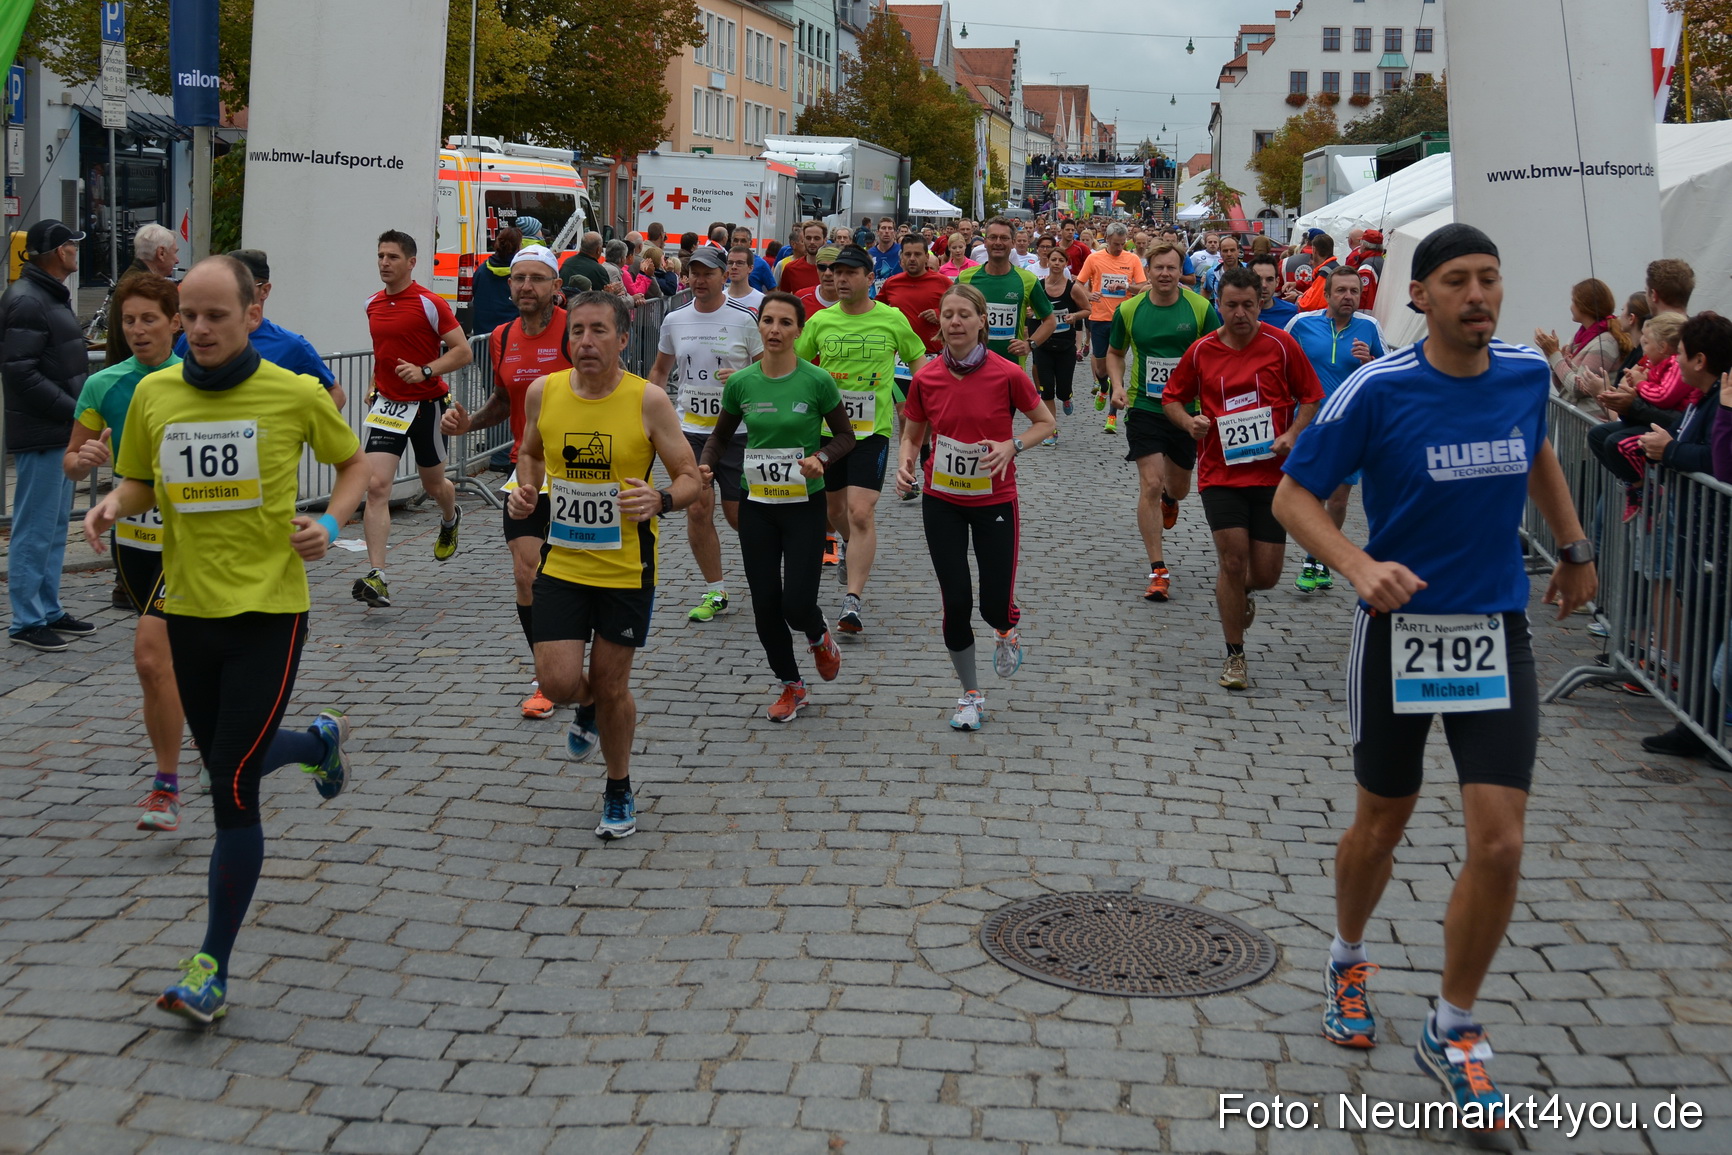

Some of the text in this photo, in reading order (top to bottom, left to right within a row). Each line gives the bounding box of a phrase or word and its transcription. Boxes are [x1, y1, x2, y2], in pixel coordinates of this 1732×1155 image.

[106, 2, 119, 35] P
[178, 69, 219, 88] railon
[46, 144, 53, 163] 3
[249, 148, 404, 170] www.bmw-laufsport.de
[1487, 160, 1655, 183] www.bmw-laufsport.de
[692, 187, 734, 196] Bayerisches
[1084, 180, 1114, 188] START
[691, 204, 711, 212] Kreuz
[380, 401, 409, 419] 302
[691, 397, 720, 415] 516
[372, 416, 402, 428] Alexander
[1219, 413, 1265, 426] PARTL Neumarkt
[194, 430, 240, 440] Neumarkt
[1225, 420, 1269, 446] 2317
[937, 440, 981, 455] PARTL Neumarkt
[1426, 438, 1527, 469] HUBER
[179, 444, 239, 478] 168
[945, 452, 979, 476] 167
[566, 469, 611, 480] HIRSCH
[756, 462, 792, 482] 187
[1452, 463, 1525, 478] TECHNOLOGY
[552, 483, 607, 497] PARTL Neumarkt
[949, 478, 971, 488] Anika
[182, 486, 239, 500] Christian
[764, 487, 790, 496] Bettina
[556, 495, 613, 525] 2403
[134, 528, 156, 542] Klara
[569, 528, 596, 541] Franz
[1394, 621, 1484, 633] PARTL Neumarkt
[1404, 635, 1496, 673] 2192
[1421, 681, 1480, 698] Michael
